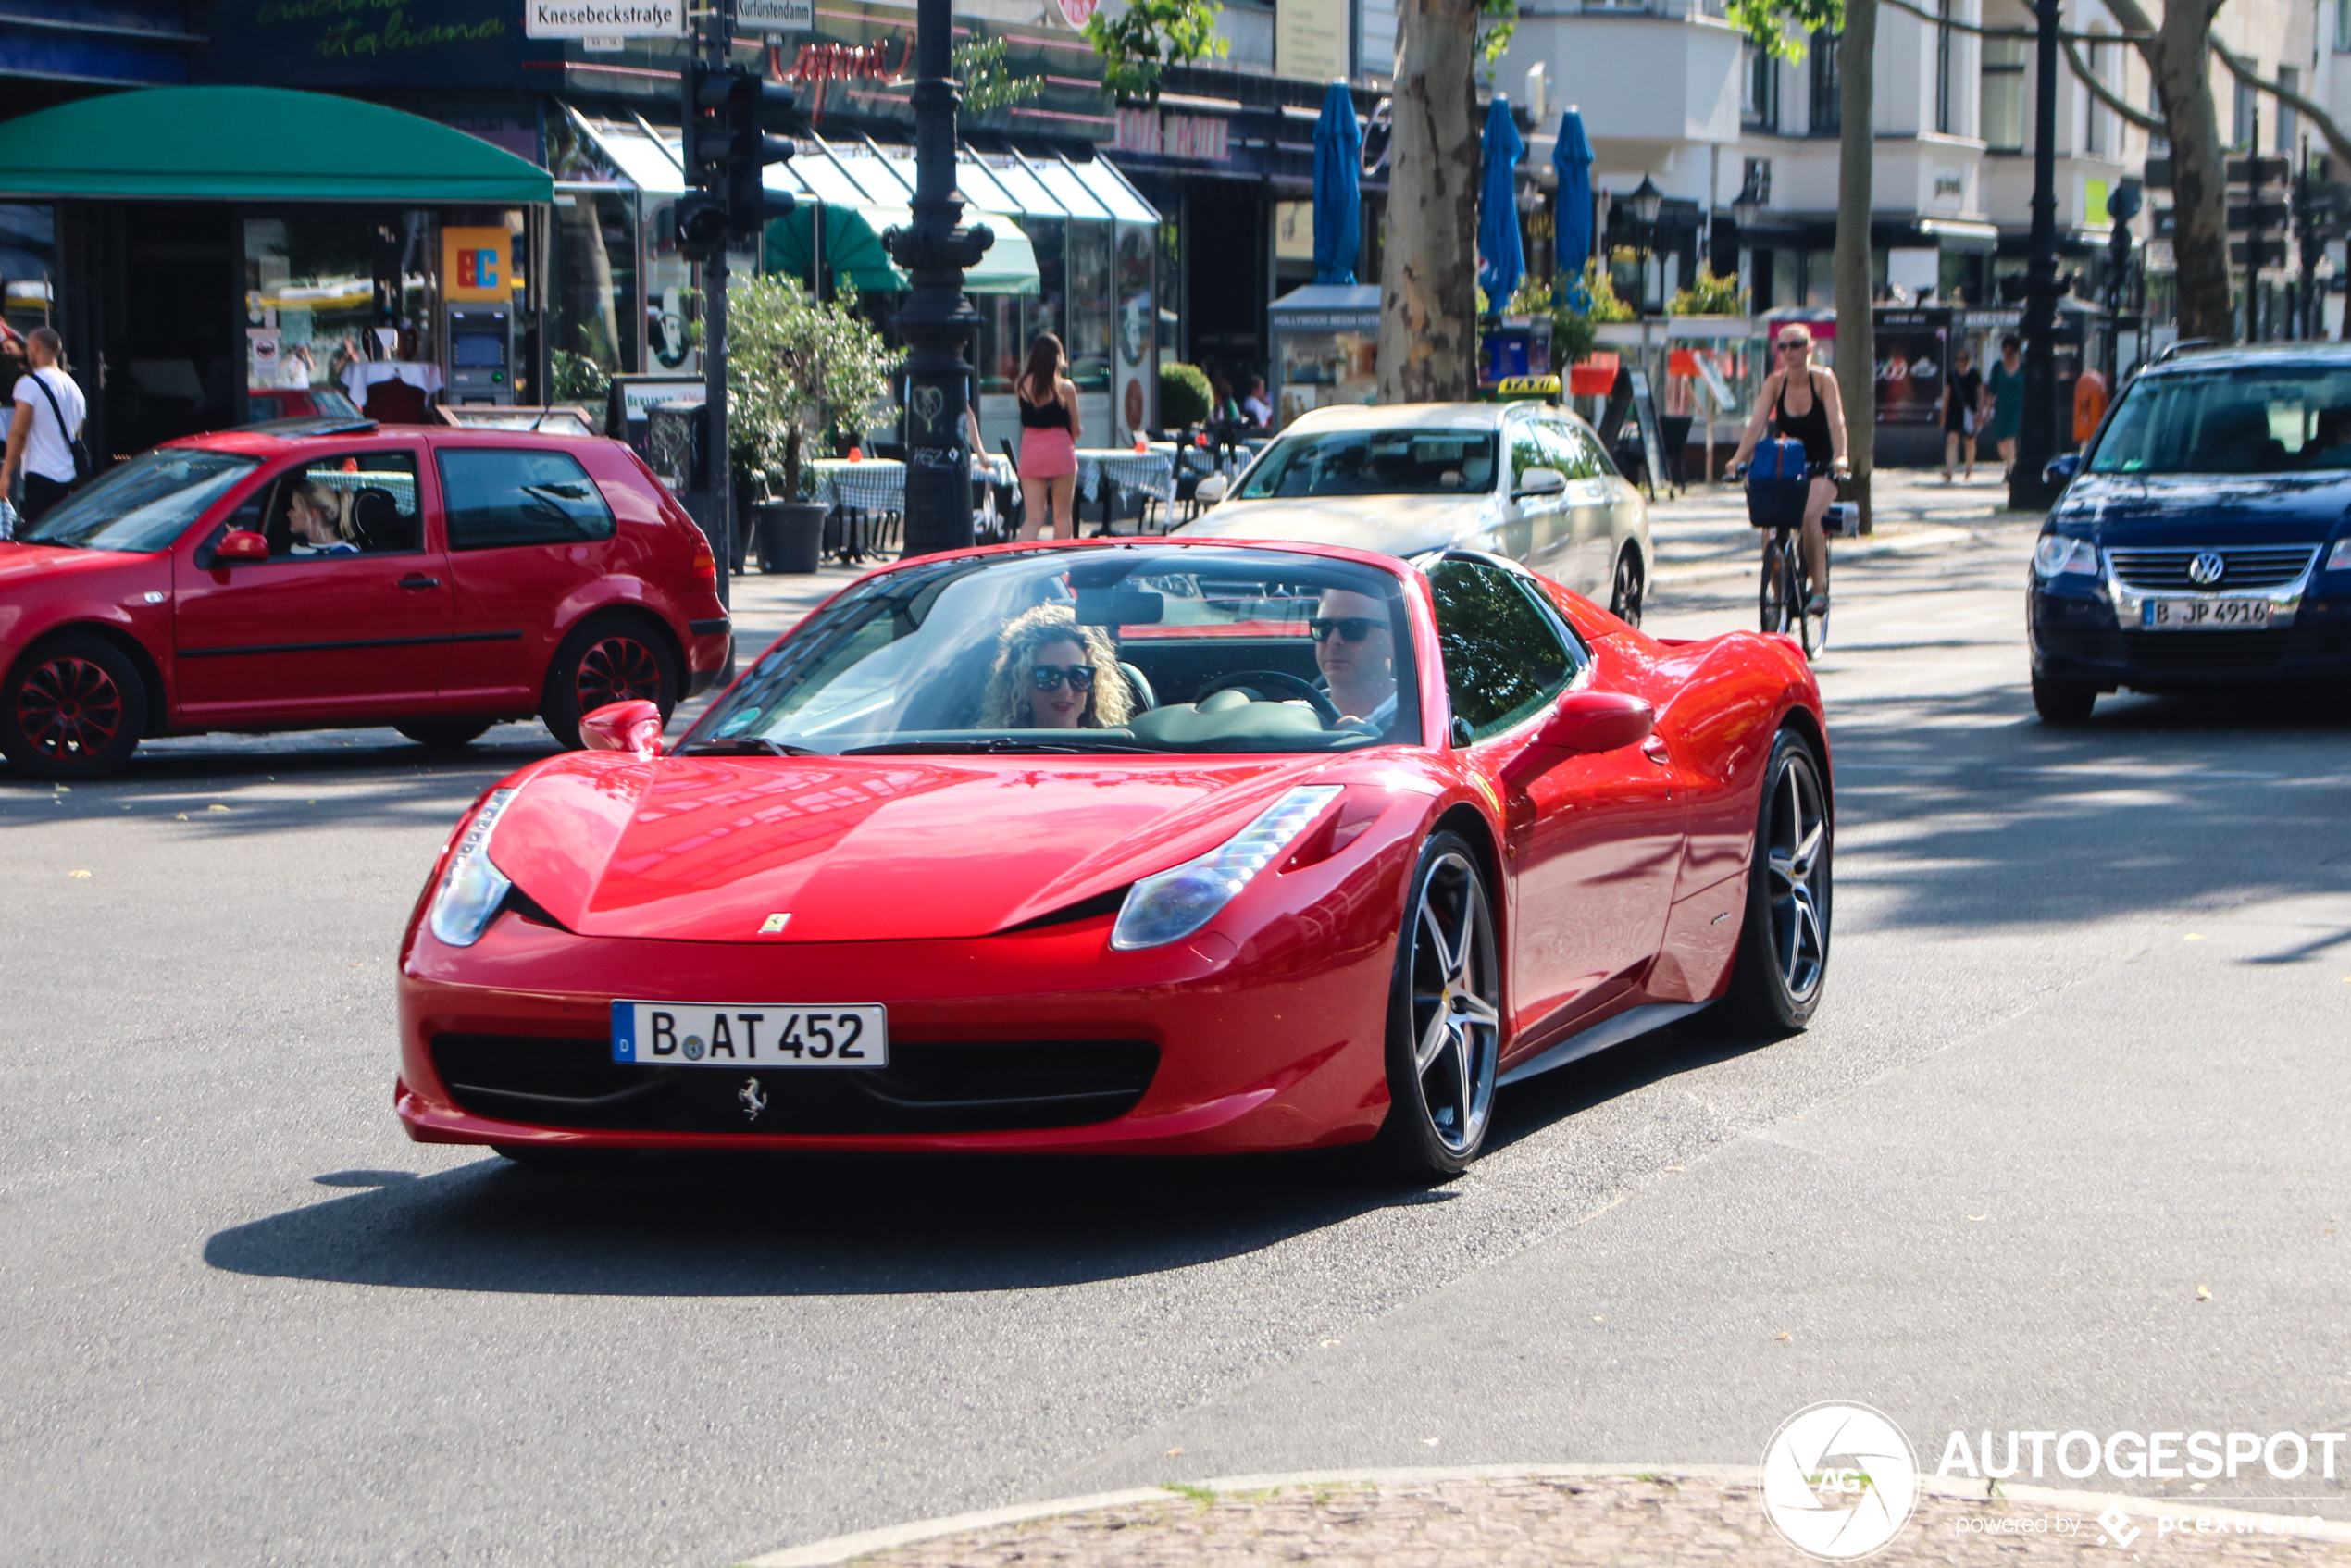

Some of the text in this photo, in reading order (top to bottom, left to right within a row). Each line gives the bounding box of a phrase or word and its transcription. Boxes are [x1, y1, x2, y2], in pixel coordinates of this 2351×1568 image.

[539, 5, 672, 28] Knesebeckstraße
[739, 0, 809, 20] Kurfürstendamm
[1113, 107, 1231, 160] EDIA HOTEL
[1274, 316, 1380, 327] HOLLYWOOD MEDIA HOTE
[1506, 379, 1551, 390] TAXI
[2156, 604, 2265, 624] B JP 4916
[652, 1011, 678, 1056] B
[710, 1013, 765, 1058] AT
[778, 1014, 865, 1059] 452
